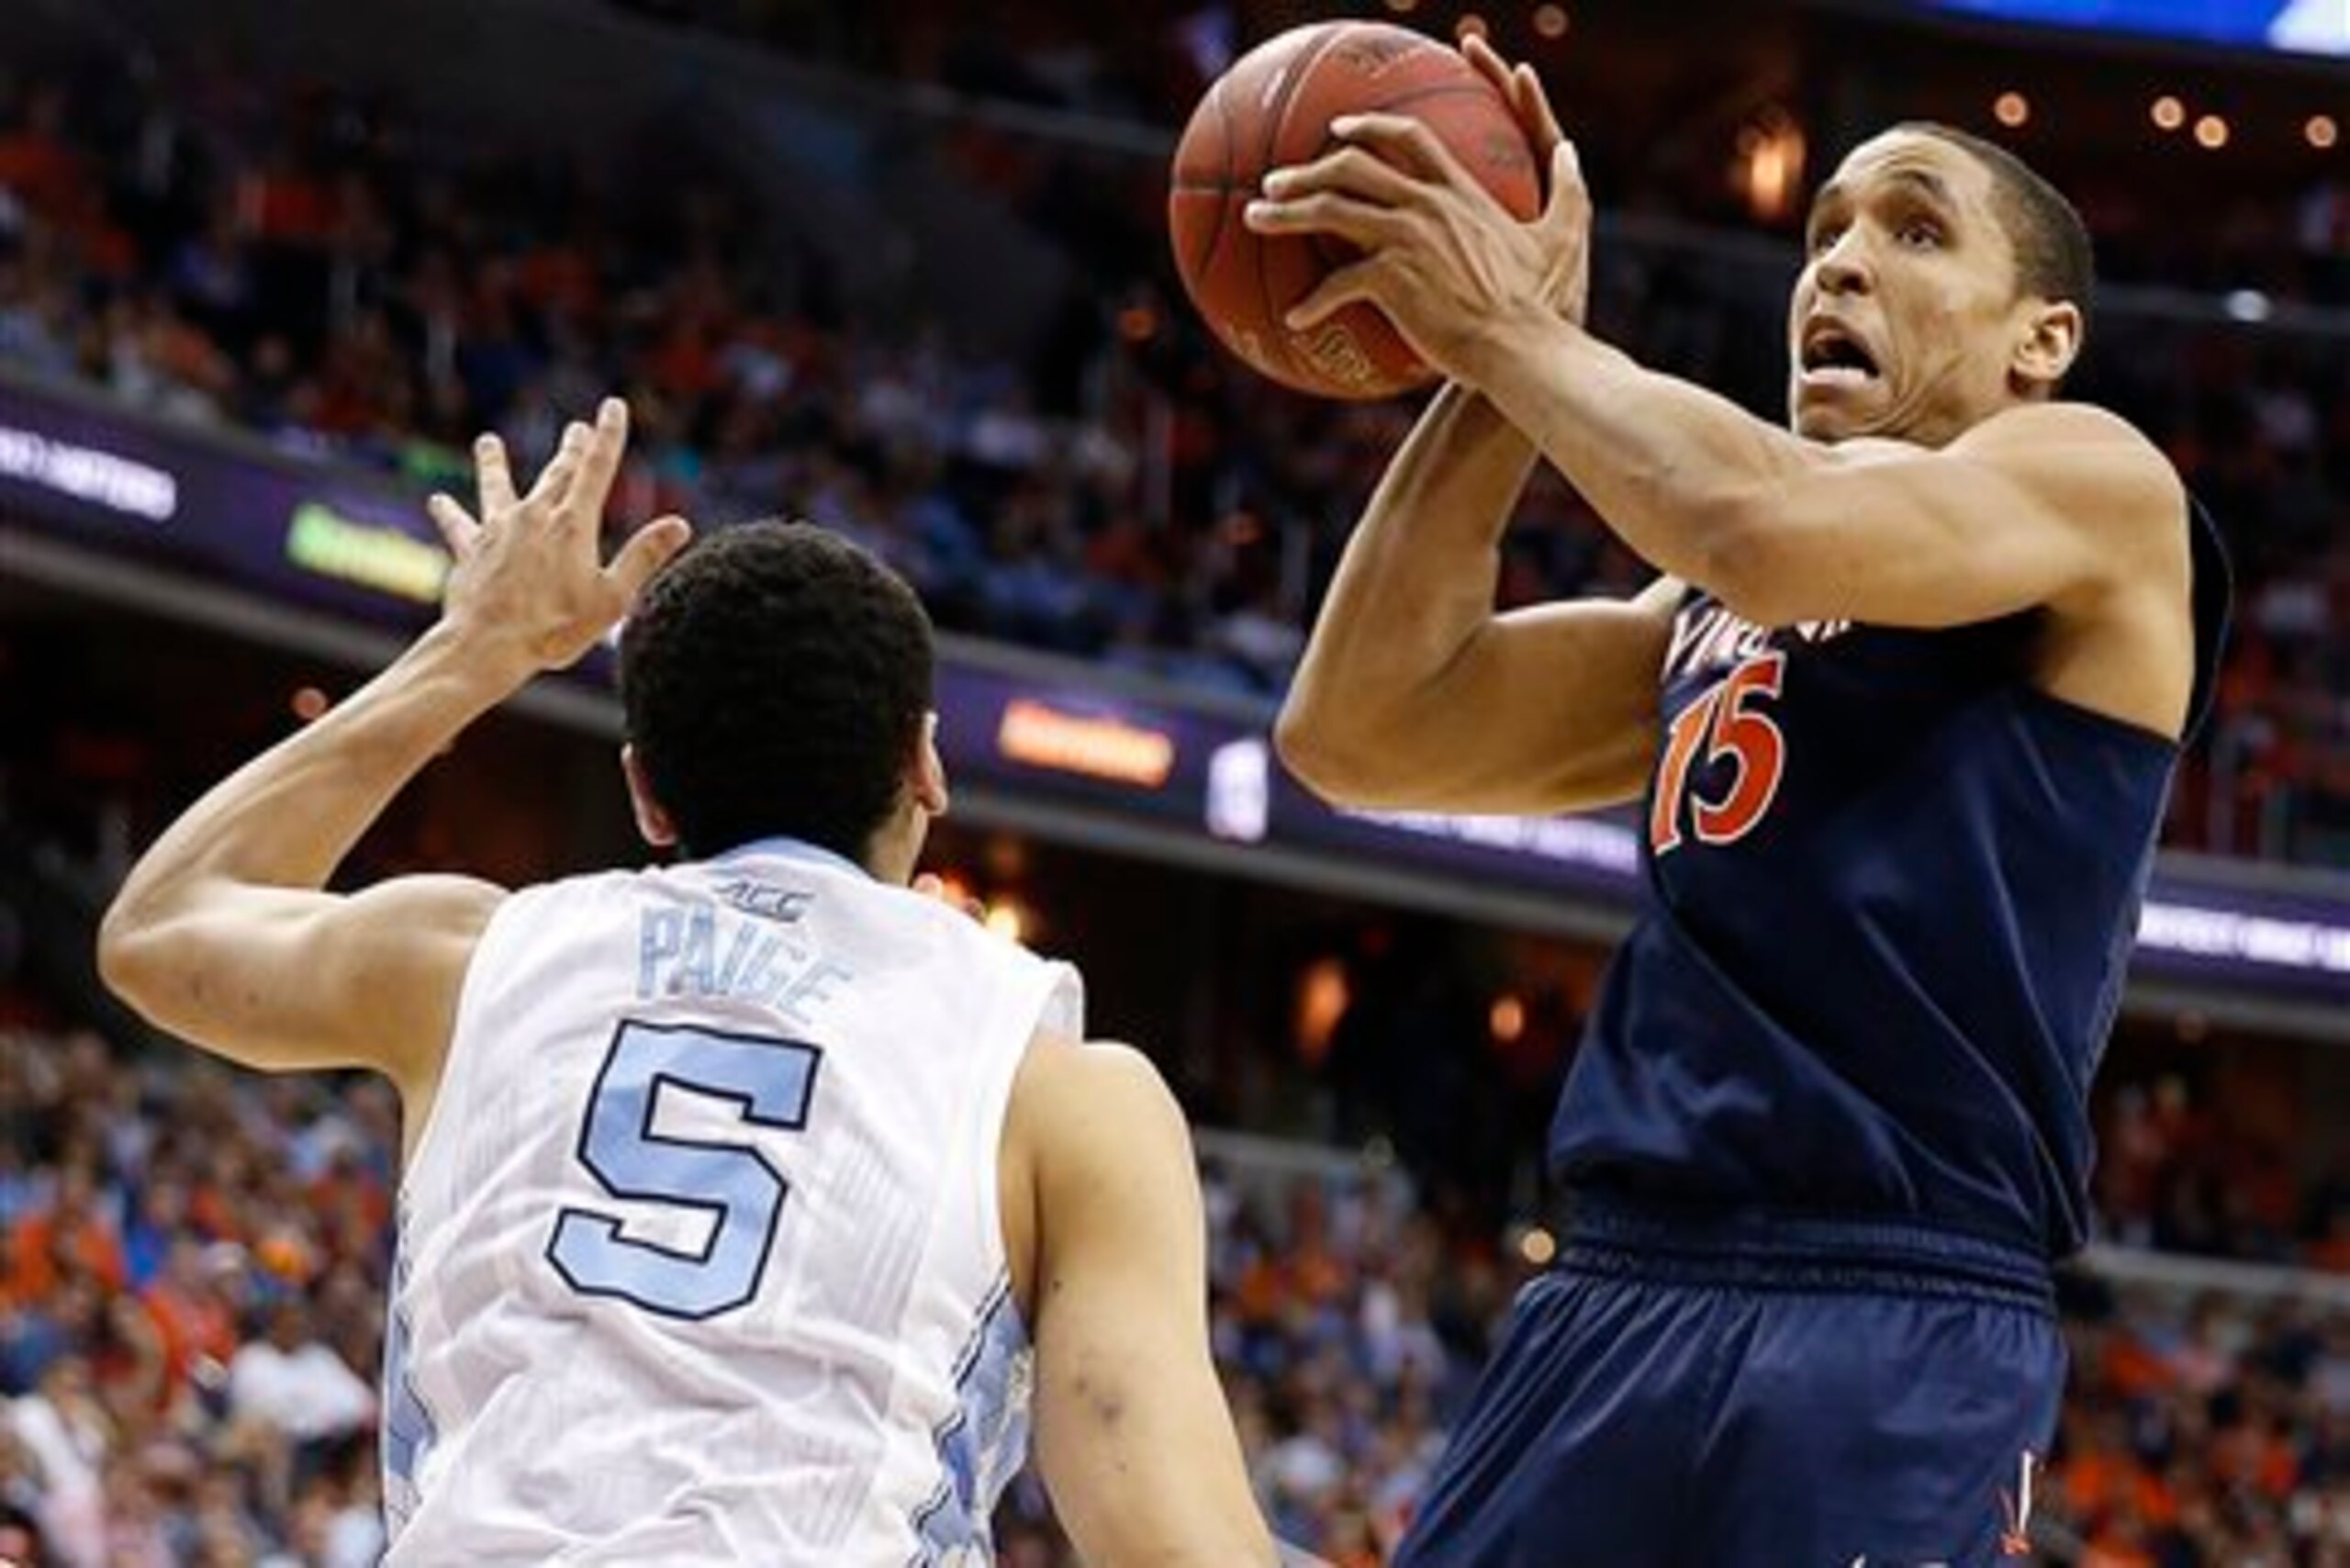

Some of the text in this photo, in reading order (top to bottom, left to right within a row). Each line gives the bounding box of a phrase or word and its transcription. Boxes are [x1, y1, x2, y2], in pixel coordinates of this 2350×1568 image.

[1650, 649, 1785, 856] 15
[636, 900, 854, 1025] PAIGE
[712, 881, 815, 924] ACC
[544, 1019, 823, 1320] 5
